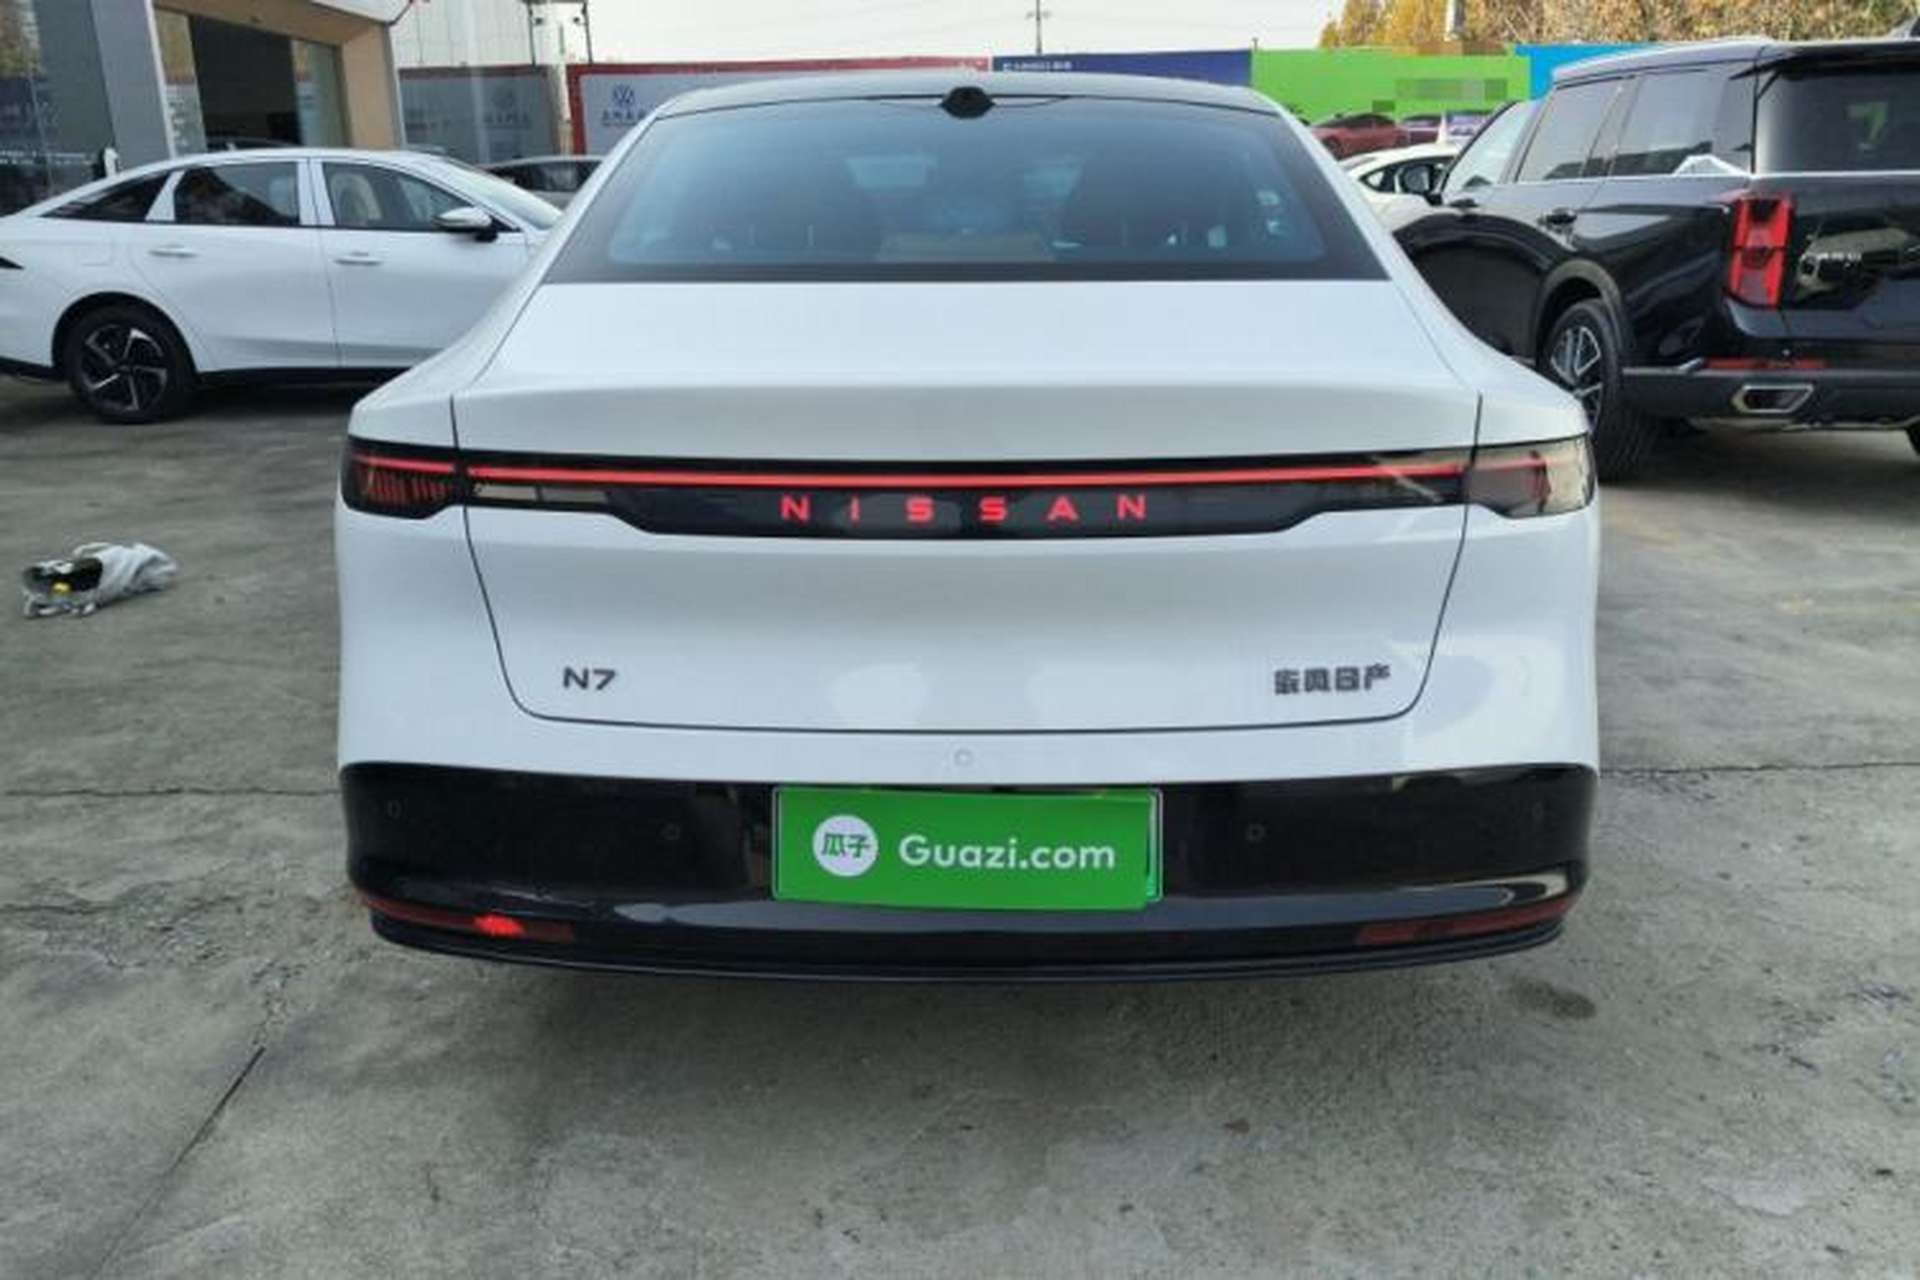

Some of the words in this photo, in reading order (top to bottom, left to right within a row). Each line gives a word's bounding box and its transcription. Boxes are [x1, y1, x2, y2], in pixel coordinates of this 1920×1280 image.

[780, 494, 1148, 522] NISSAN
[562, 666, 616, 691] N7
[821, 833, 870, 858] 瓜子
[898, 835, 1117, 869] Guazi.com
